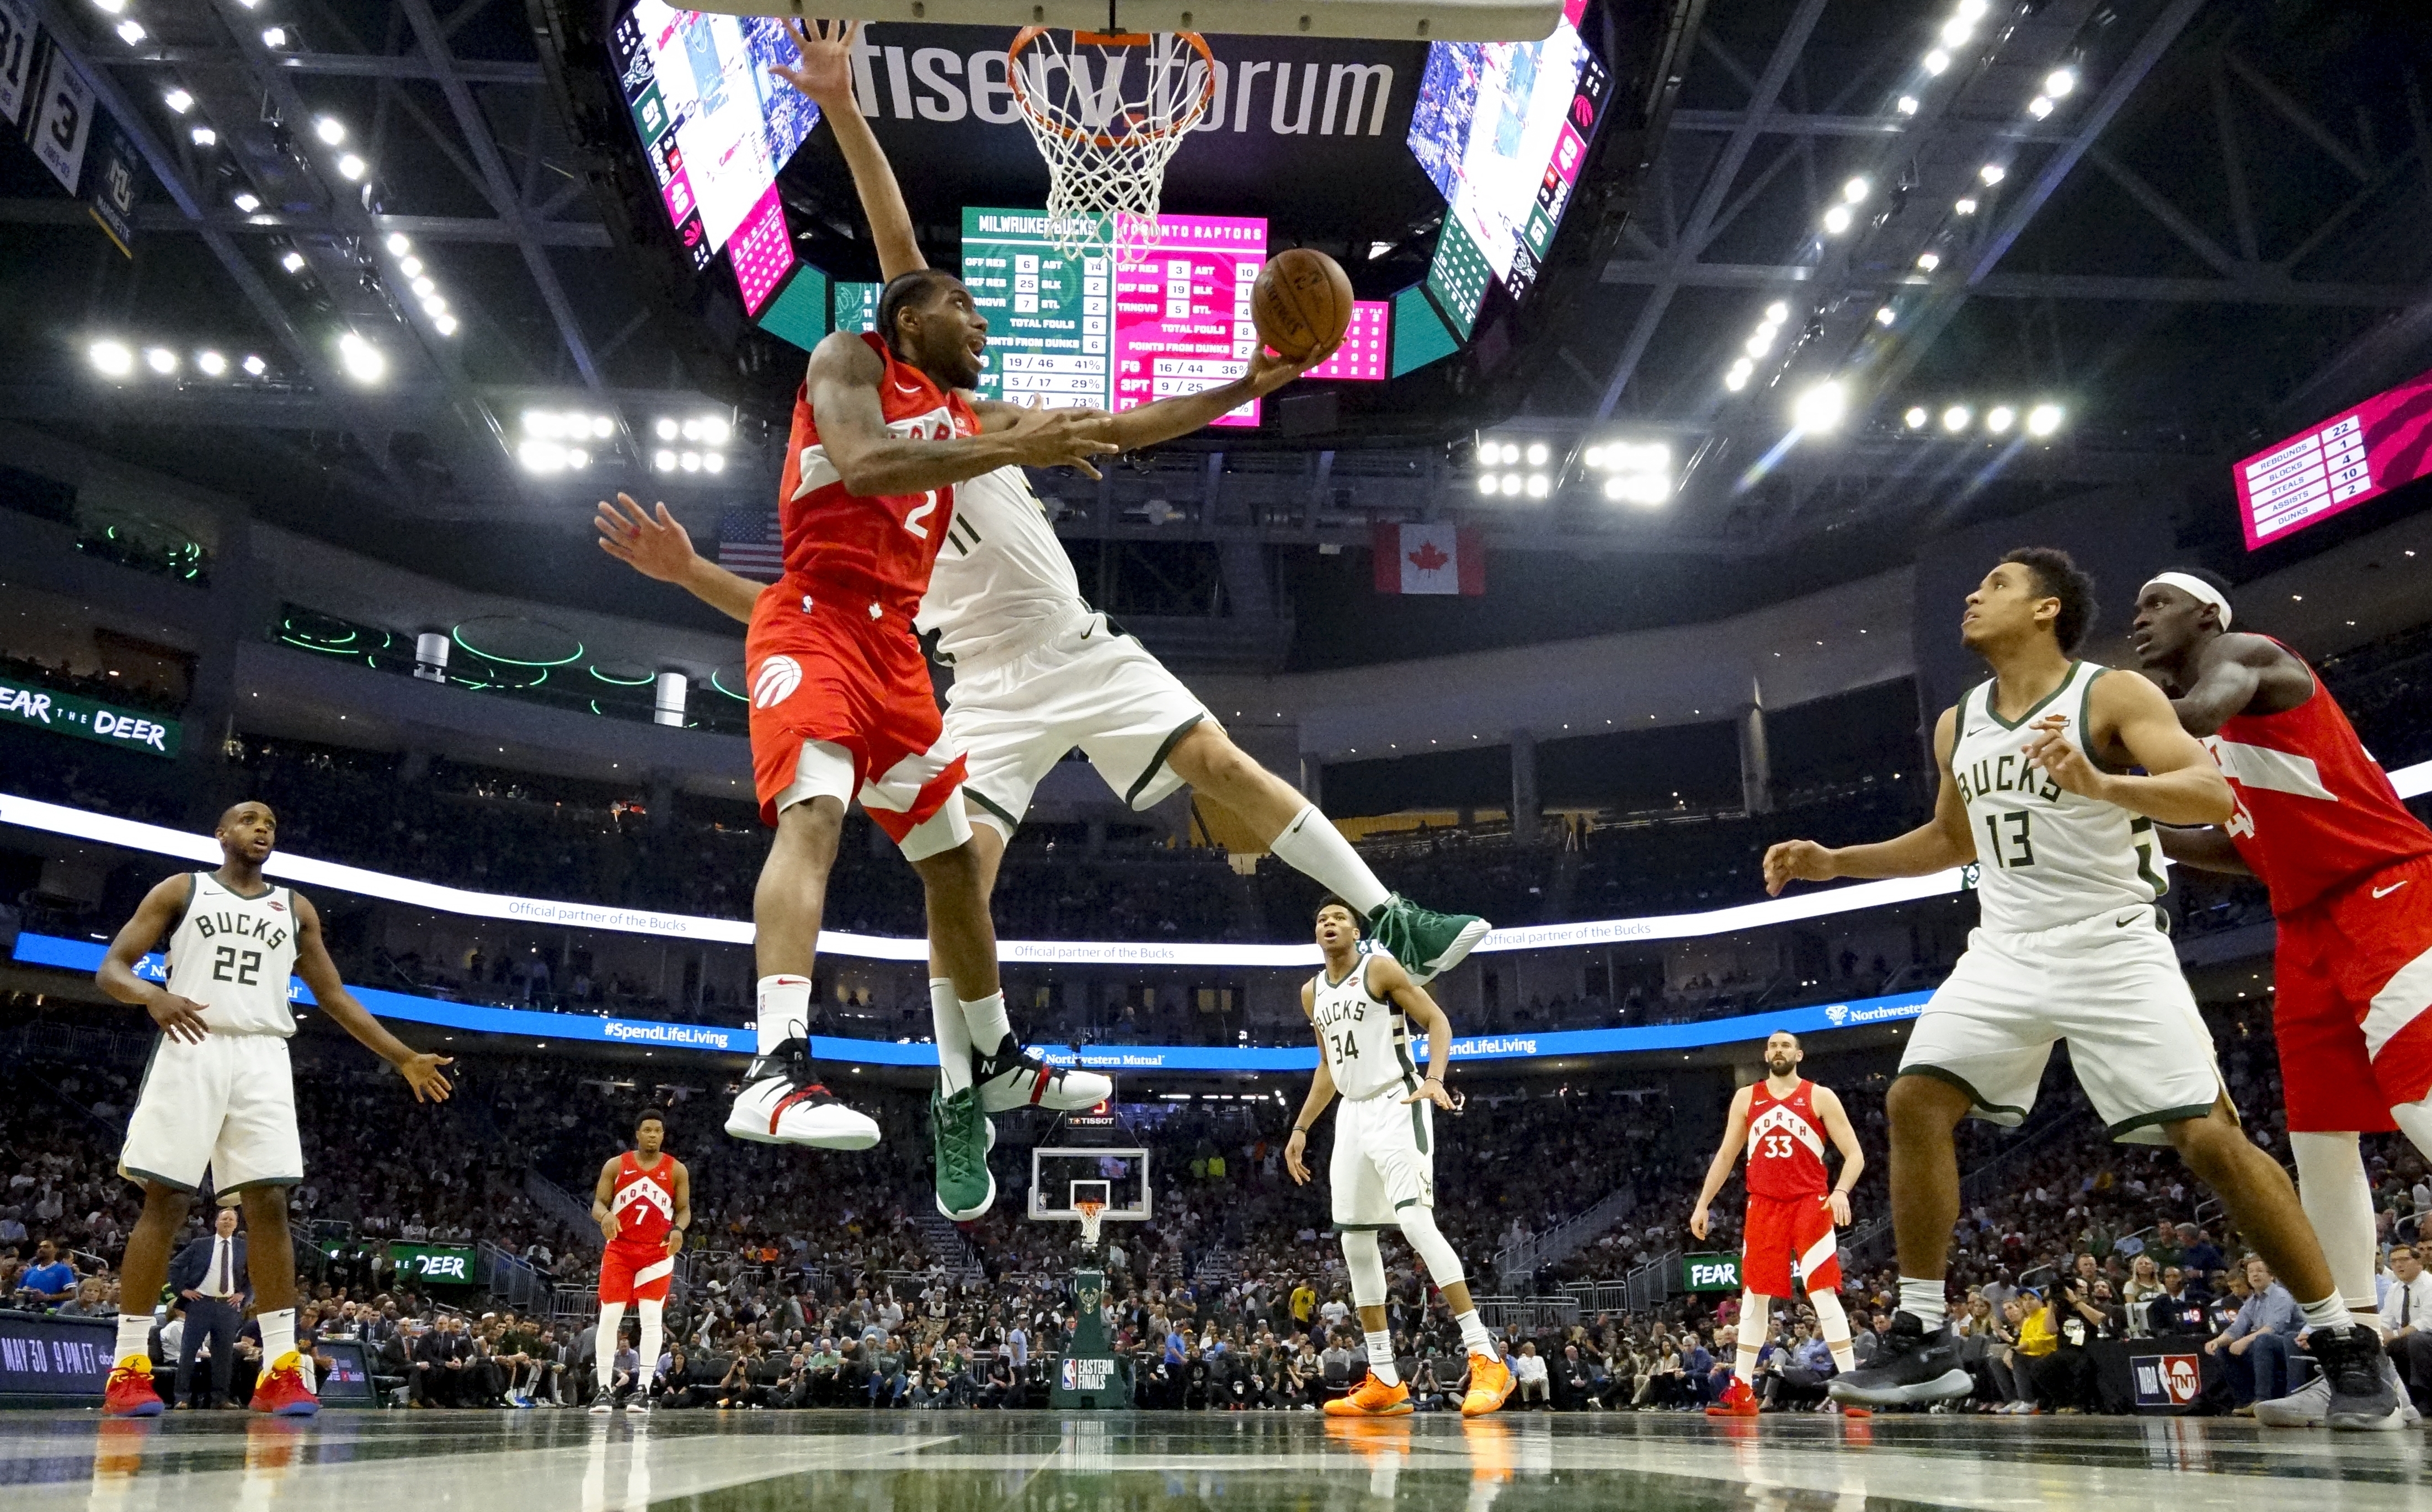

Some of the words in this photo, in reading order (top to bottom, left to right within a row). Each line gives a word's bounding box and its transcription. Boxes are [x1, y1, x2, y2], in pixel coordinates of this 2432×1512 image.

[1146, 32, 1393, 136] forum
[52, 93, 78, 152] 3
[642, 98, 662, 132] 51
[1559, 136, 1577, 170] 49
[671, 182, 689, 215] 49
[1548, 180, 1567, 220] 10:40
[1194, 226, 1261, 241] RAPTORS
[1530, 216, 1546, 246] 51
[965, 258, 984, 266] OFF
[986, 259, 1006, 268] REB
[1043, 261, 1063, 269] AST
[1118, 264, 1137, 273] OFF
[1138, 265, 1159, 273] REB
[1194, 266, 1215, 275] AST
[965, 277, 984, 286] DEF
[986, 279, 1006, 287] REB
[1042, 280, 1061, 289] BLK
[1117, 283, 1137, 292] DEF
[1138, 284, 1159, 293] REB
[1193, 286, 1213, 295] BLK
[1042, 300, 1060, 309] STL
[1117, 303, 1158, 313] TRNOVR
[1193, 306, 1211, 314] STL
[1010, 318, 1041, 328] TOTAL
[1043, 320, 1075, 329] FOULS
[1161, 324, 1192, 333] TOTAL
[1194, 325, 1226, 334] FOULS
[1016, 338, 1043, 347] FROM
[1046, 339, 1079, 348] DUNKS
[1129, 341, 1164, 351] POINTS
[1166, 343, 1194, 352] FROM
[1196, 344, 1230, 354] DUNKS
[1075, 360, 1100, 370] 41%
[1121, 360, 1140, 372] FG
[980, 375, 999, 386] PT
[1071, 380, 1100, 388] 29%
[1121, 379, 1150, 392] 3PT
[1188, 383, 1203, 392] 25
[1072, 398, 1099, 407] 73%
[1120, 398, 1138, 409] FT
[2260, 444, 2307, 470] REBOUNDS
[2333, 423, 2349, 437] 22
[2269, 462, 2302, 482] BLOCKS
[2340, 440, 2347, 448] 1
[2271, 477, 2304, 496] STEALS
[2342, 455, 2351, 464] 4
[2272, 490, 2308, 511] ASSISTS
[2342, 468, 2357, 480] 10
[904, 490, 937, 539] 2
[2278, 507, 2308, 525] DUNKS
[2348, 485, 2356, 494] 2
[0, 687, 51, 723] EAR
[57, 708, 87, 724] THE
[94, 710, 165, 751] DEER
[1958, 755, 2062, 805] BUCKS
[1986, 810, 2035, 868] 13
[509, 902, 555, 917] Official
[559, 910, 606, 922] partner
[610, 913, 623, 924] of
[626, 915, 646, 927] the
[650, 917, 686, 931] Bucks
[195, 912, 287, 950] BUCKS
[1484, 933, 1524, 945] Official
[1529, 931, 1573, 944] partner
[1576, 927, 1588, 938] of
[1591, 926, 1611, 937] the
[1614, 923, 1651, 936] Bucks
[1015, 945, 1055, 957] Official
[1059, 947, 1101, 959] partner
[1104, 947, 1116, 958] of
[1119, 947, 1137, 958] the
[1141, 948, 1174, 958] Bucks
[213, 945, 262, 986] 22
[1316, 1000, 1367, 1033] BUCKS
[1850, 1003, 1928, 1022] Northwester
[604, 1022, 728, 1048] #SpendLifeLiving
[1330, 1030, 1359, 1065] 34
[1420, 1038, 1536, 1057] #endLifeLiving
[1754, 1112, 1806, 1136] NORTH
[1764, 1136, 1793, 1158] 33
[620, 1183, 667, 1206] NORTH
[635, 1205, 648, 1225] 7
[1691, 1263, 1738, 1287] FEAR
[1, 1338, 28, 1371] MAY
[29, 1339, 47, 1372] 30
[53, 1341, 63, 1373] 9
[63, 1342, 83, 1373] PM
[82, 1343, 96, 1374] ET
[1078, 1360, 1114, 1375] EASTERN
[1078, 1375, 1106, 1390] FINALS
[2137, 1366, 2159, 1394] NBA
